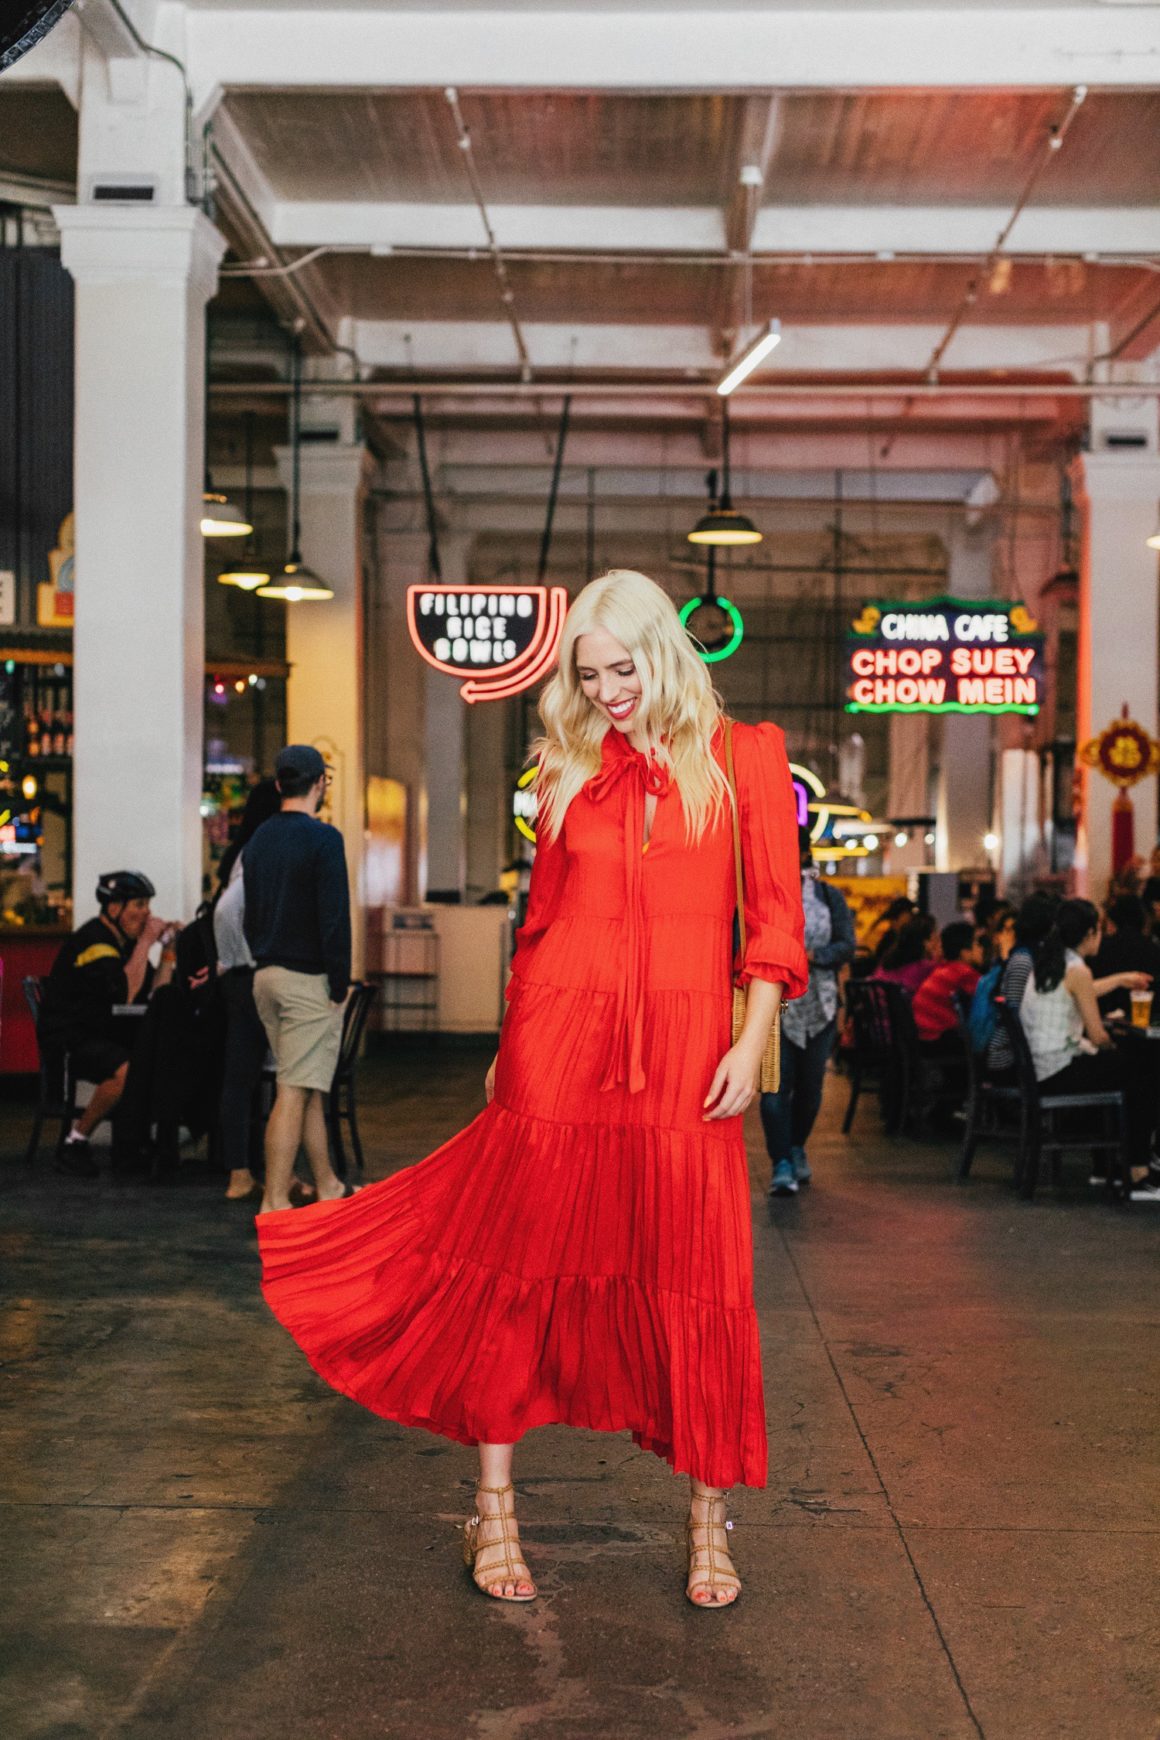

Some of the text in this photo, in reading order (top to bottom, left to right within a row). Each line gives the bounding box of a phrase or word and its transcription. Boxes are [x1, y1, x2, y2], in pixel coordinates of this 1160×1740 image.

[419, 593, 533, 618] FILIPINO
[446, 616, 507, 640] RICE
[881, 613, 1009, 642] CHINA CAFE
[434, 637, 516, 663] BOWLS
[851, 647, 1036, 676] CHOP SUEY
[852, 677, 1036, 704] CHOW MEIN
